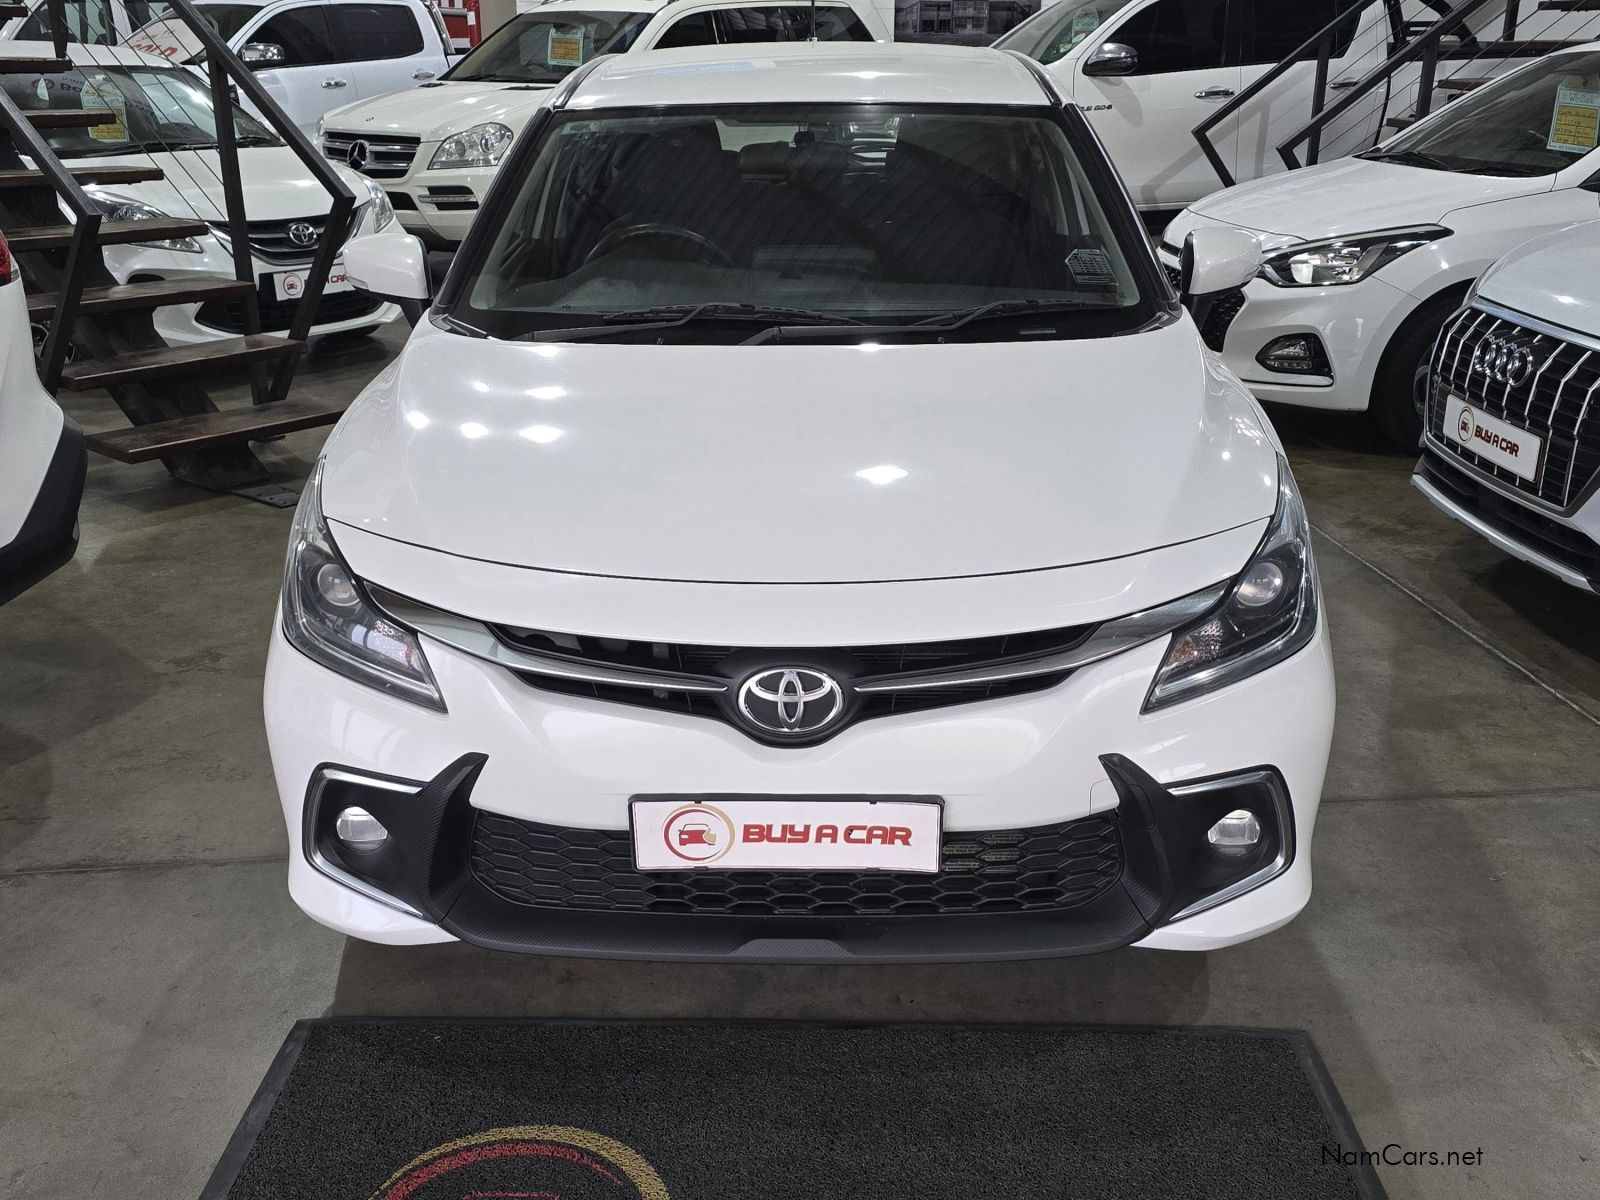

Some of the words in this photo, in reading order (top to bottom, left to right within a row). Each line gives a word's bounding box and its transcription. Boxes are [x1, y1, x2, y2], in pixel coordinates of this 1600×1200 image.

[1474, 424, 1492, 443] BUY
[1492, 434, 1500, 448] A
[1500, 438, 1520, 457] CAR
[742, 823, 811, 843] BUY
[814, 824, 838, 844] A
[843, 825, 912, 846] CAR
